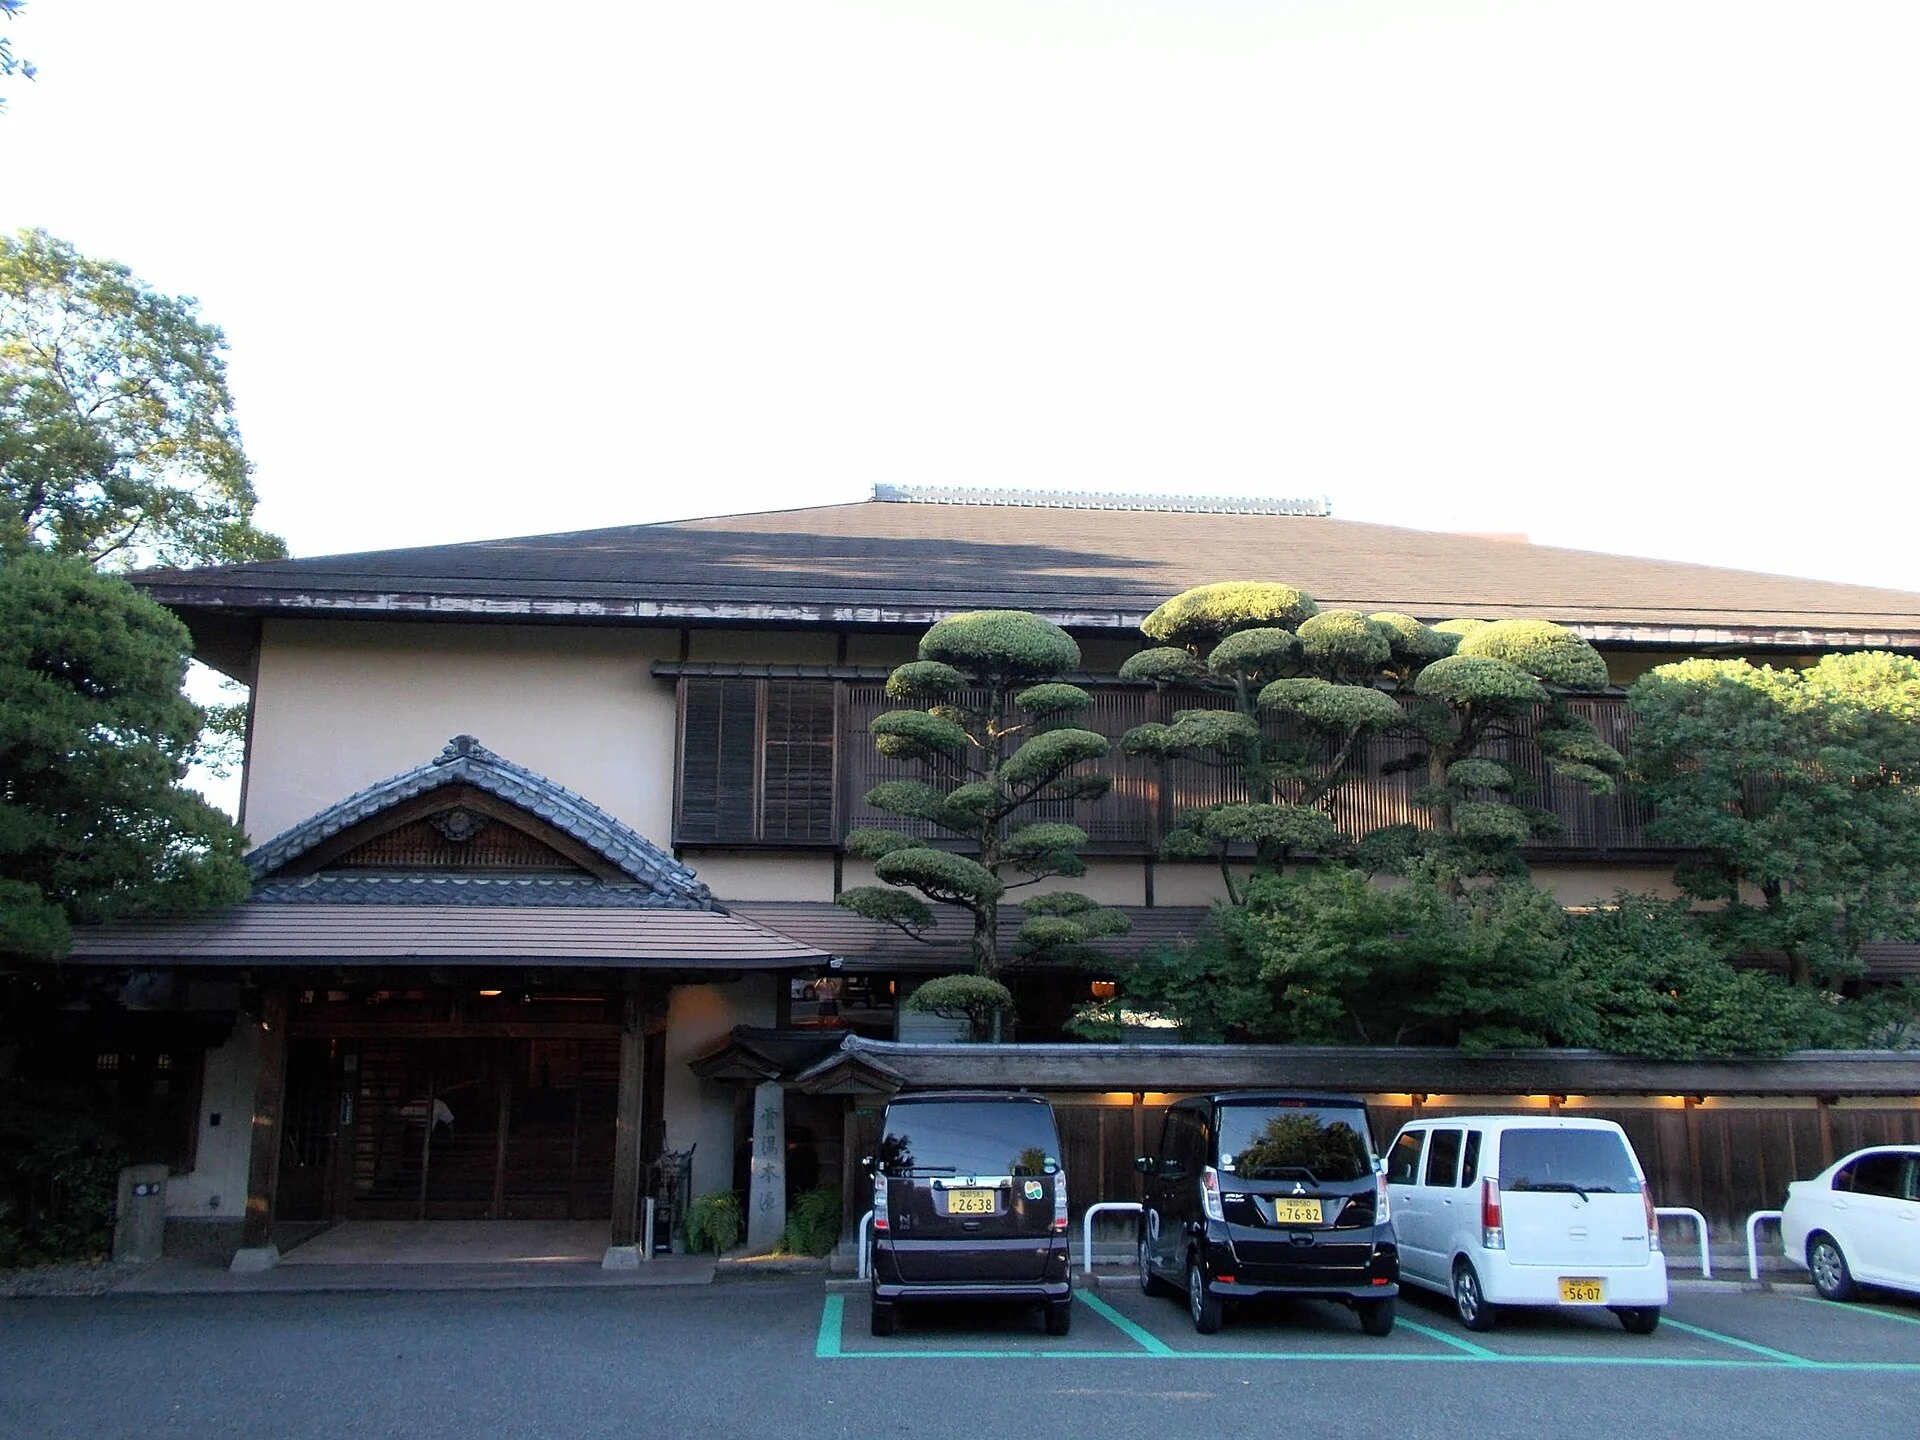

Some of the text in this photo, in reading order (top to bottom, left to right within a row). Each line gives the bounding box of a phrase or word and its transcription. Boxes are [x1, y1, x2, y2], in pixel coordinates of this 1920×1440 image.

[959, 1199, 992, 1211] 26-38
[1286, 1208, 1320, 1220] 76-82
[1569, 1288, 1600, 1300] 56-07
